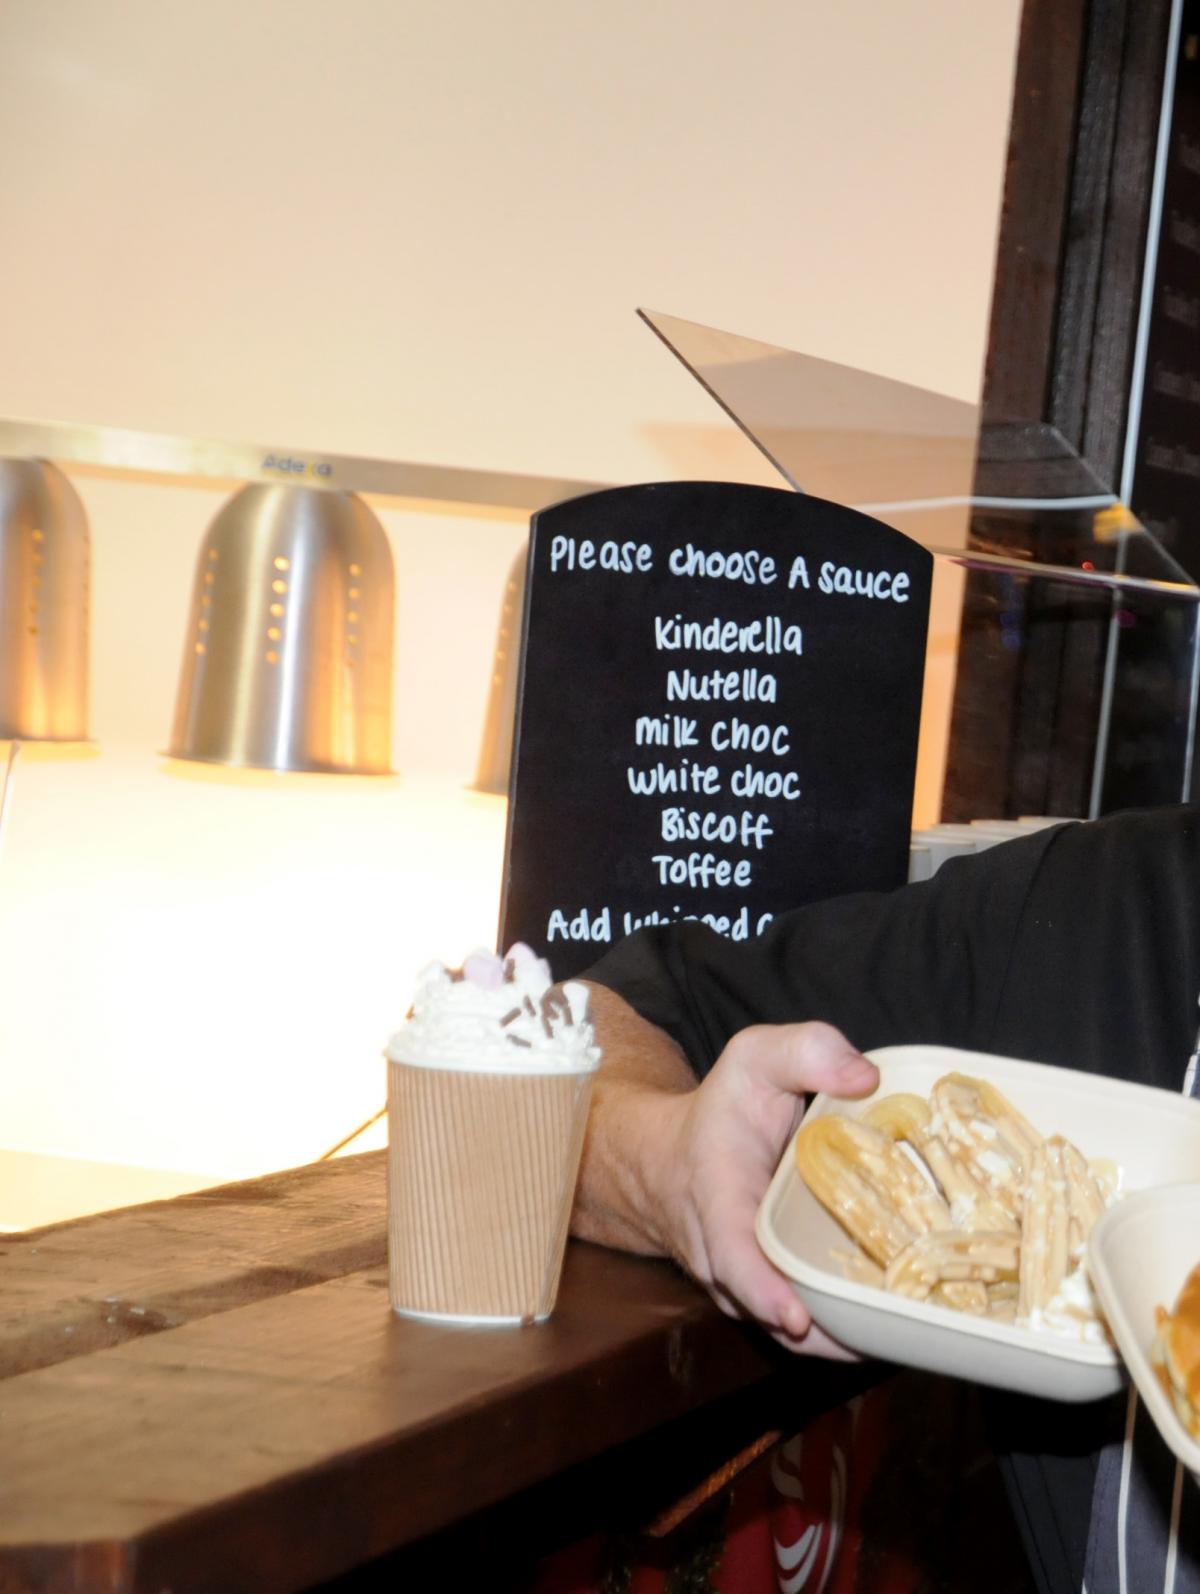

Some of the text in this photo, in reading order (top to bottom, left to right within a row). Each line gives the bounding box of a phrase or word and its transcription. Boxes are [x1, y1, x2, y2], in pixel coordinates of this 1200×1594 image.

[550, 535, 910, 603] Please choose A sauce
[666, 668, 777, 704] Nutella
[710, 717, 791, 756] choc
[730, 763, 801, 801] choc
[661, 806, 774, 850] Biscoff
[651, 852, 752, 889] Toffee
[546, 906, 612, 943] Add
